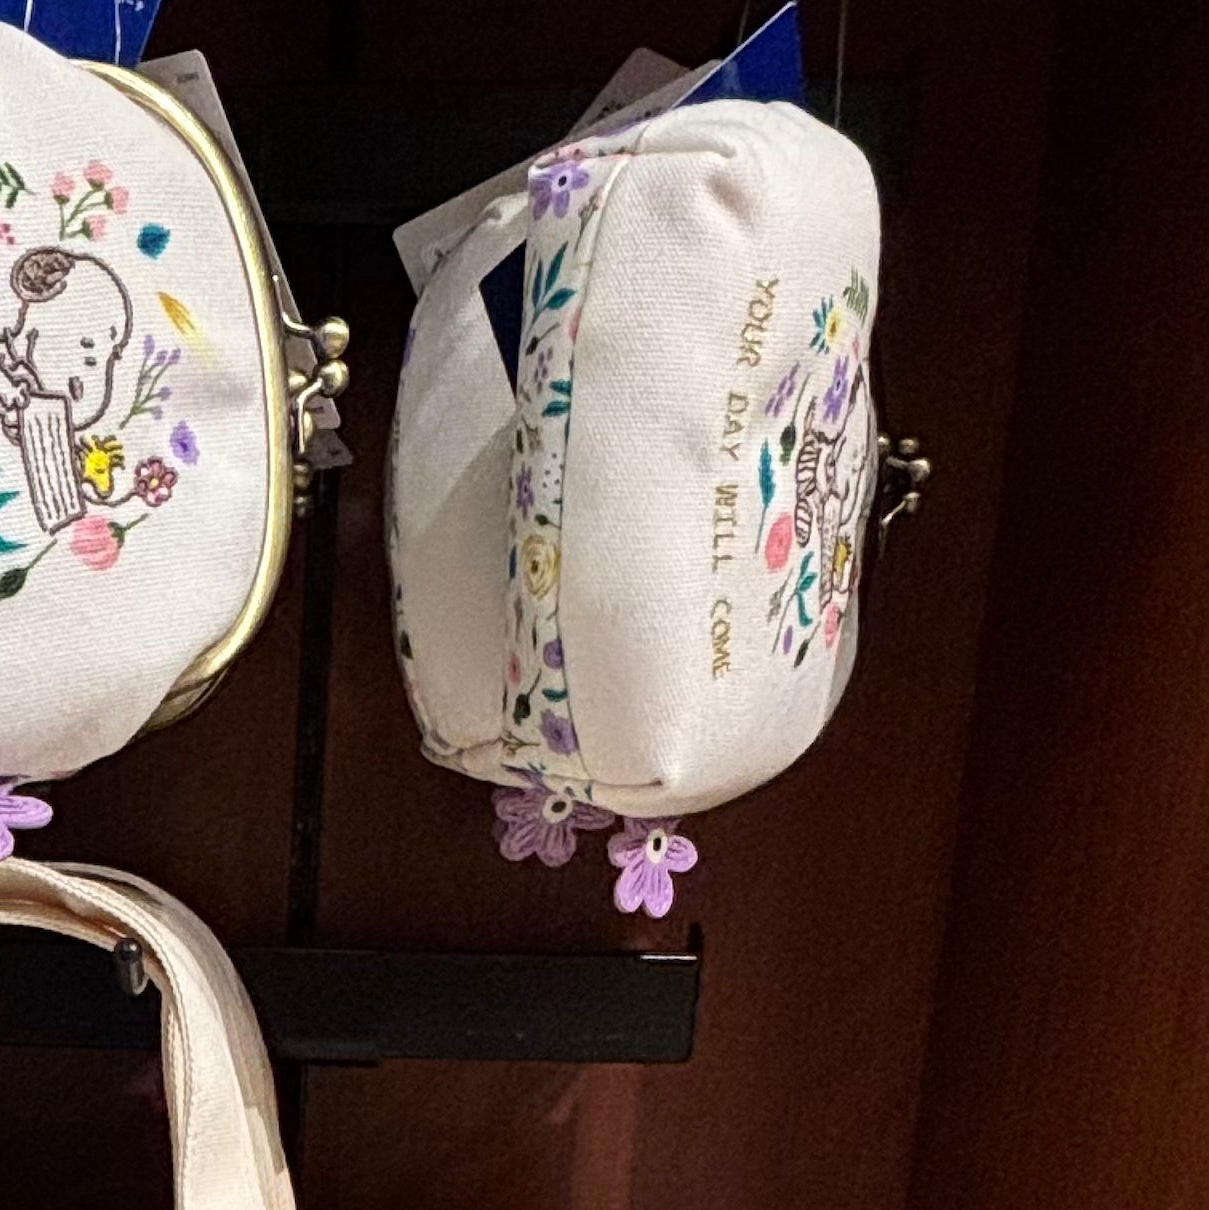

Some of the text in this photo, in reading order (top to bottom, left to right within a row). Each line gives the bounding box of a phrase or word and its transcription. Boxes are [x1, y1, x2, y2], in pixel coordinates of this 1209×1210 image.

[710, 277, 779, 679] YOUR DAY WILL COME
